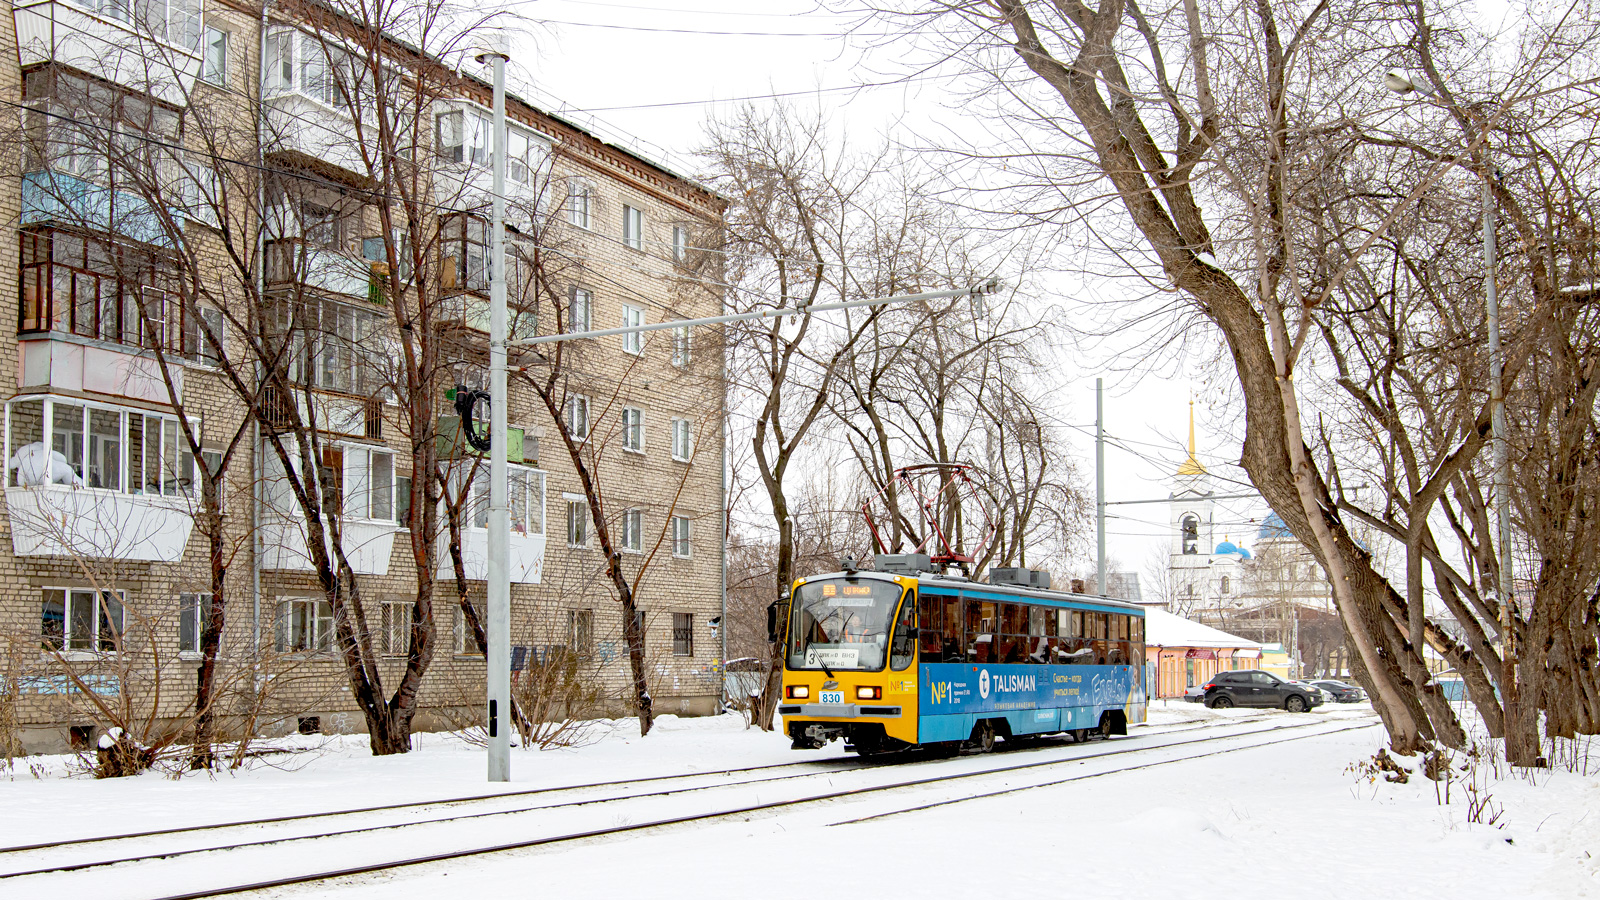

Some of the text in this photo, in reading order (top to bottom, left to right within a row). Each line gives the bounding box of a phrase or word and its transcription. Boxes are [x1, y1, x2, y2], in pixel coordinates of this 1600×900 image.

[808, 653, 816, 665] 3
[993, 675, 1036, 693] TALISMAN
[822, 694, 841, 703] 830
